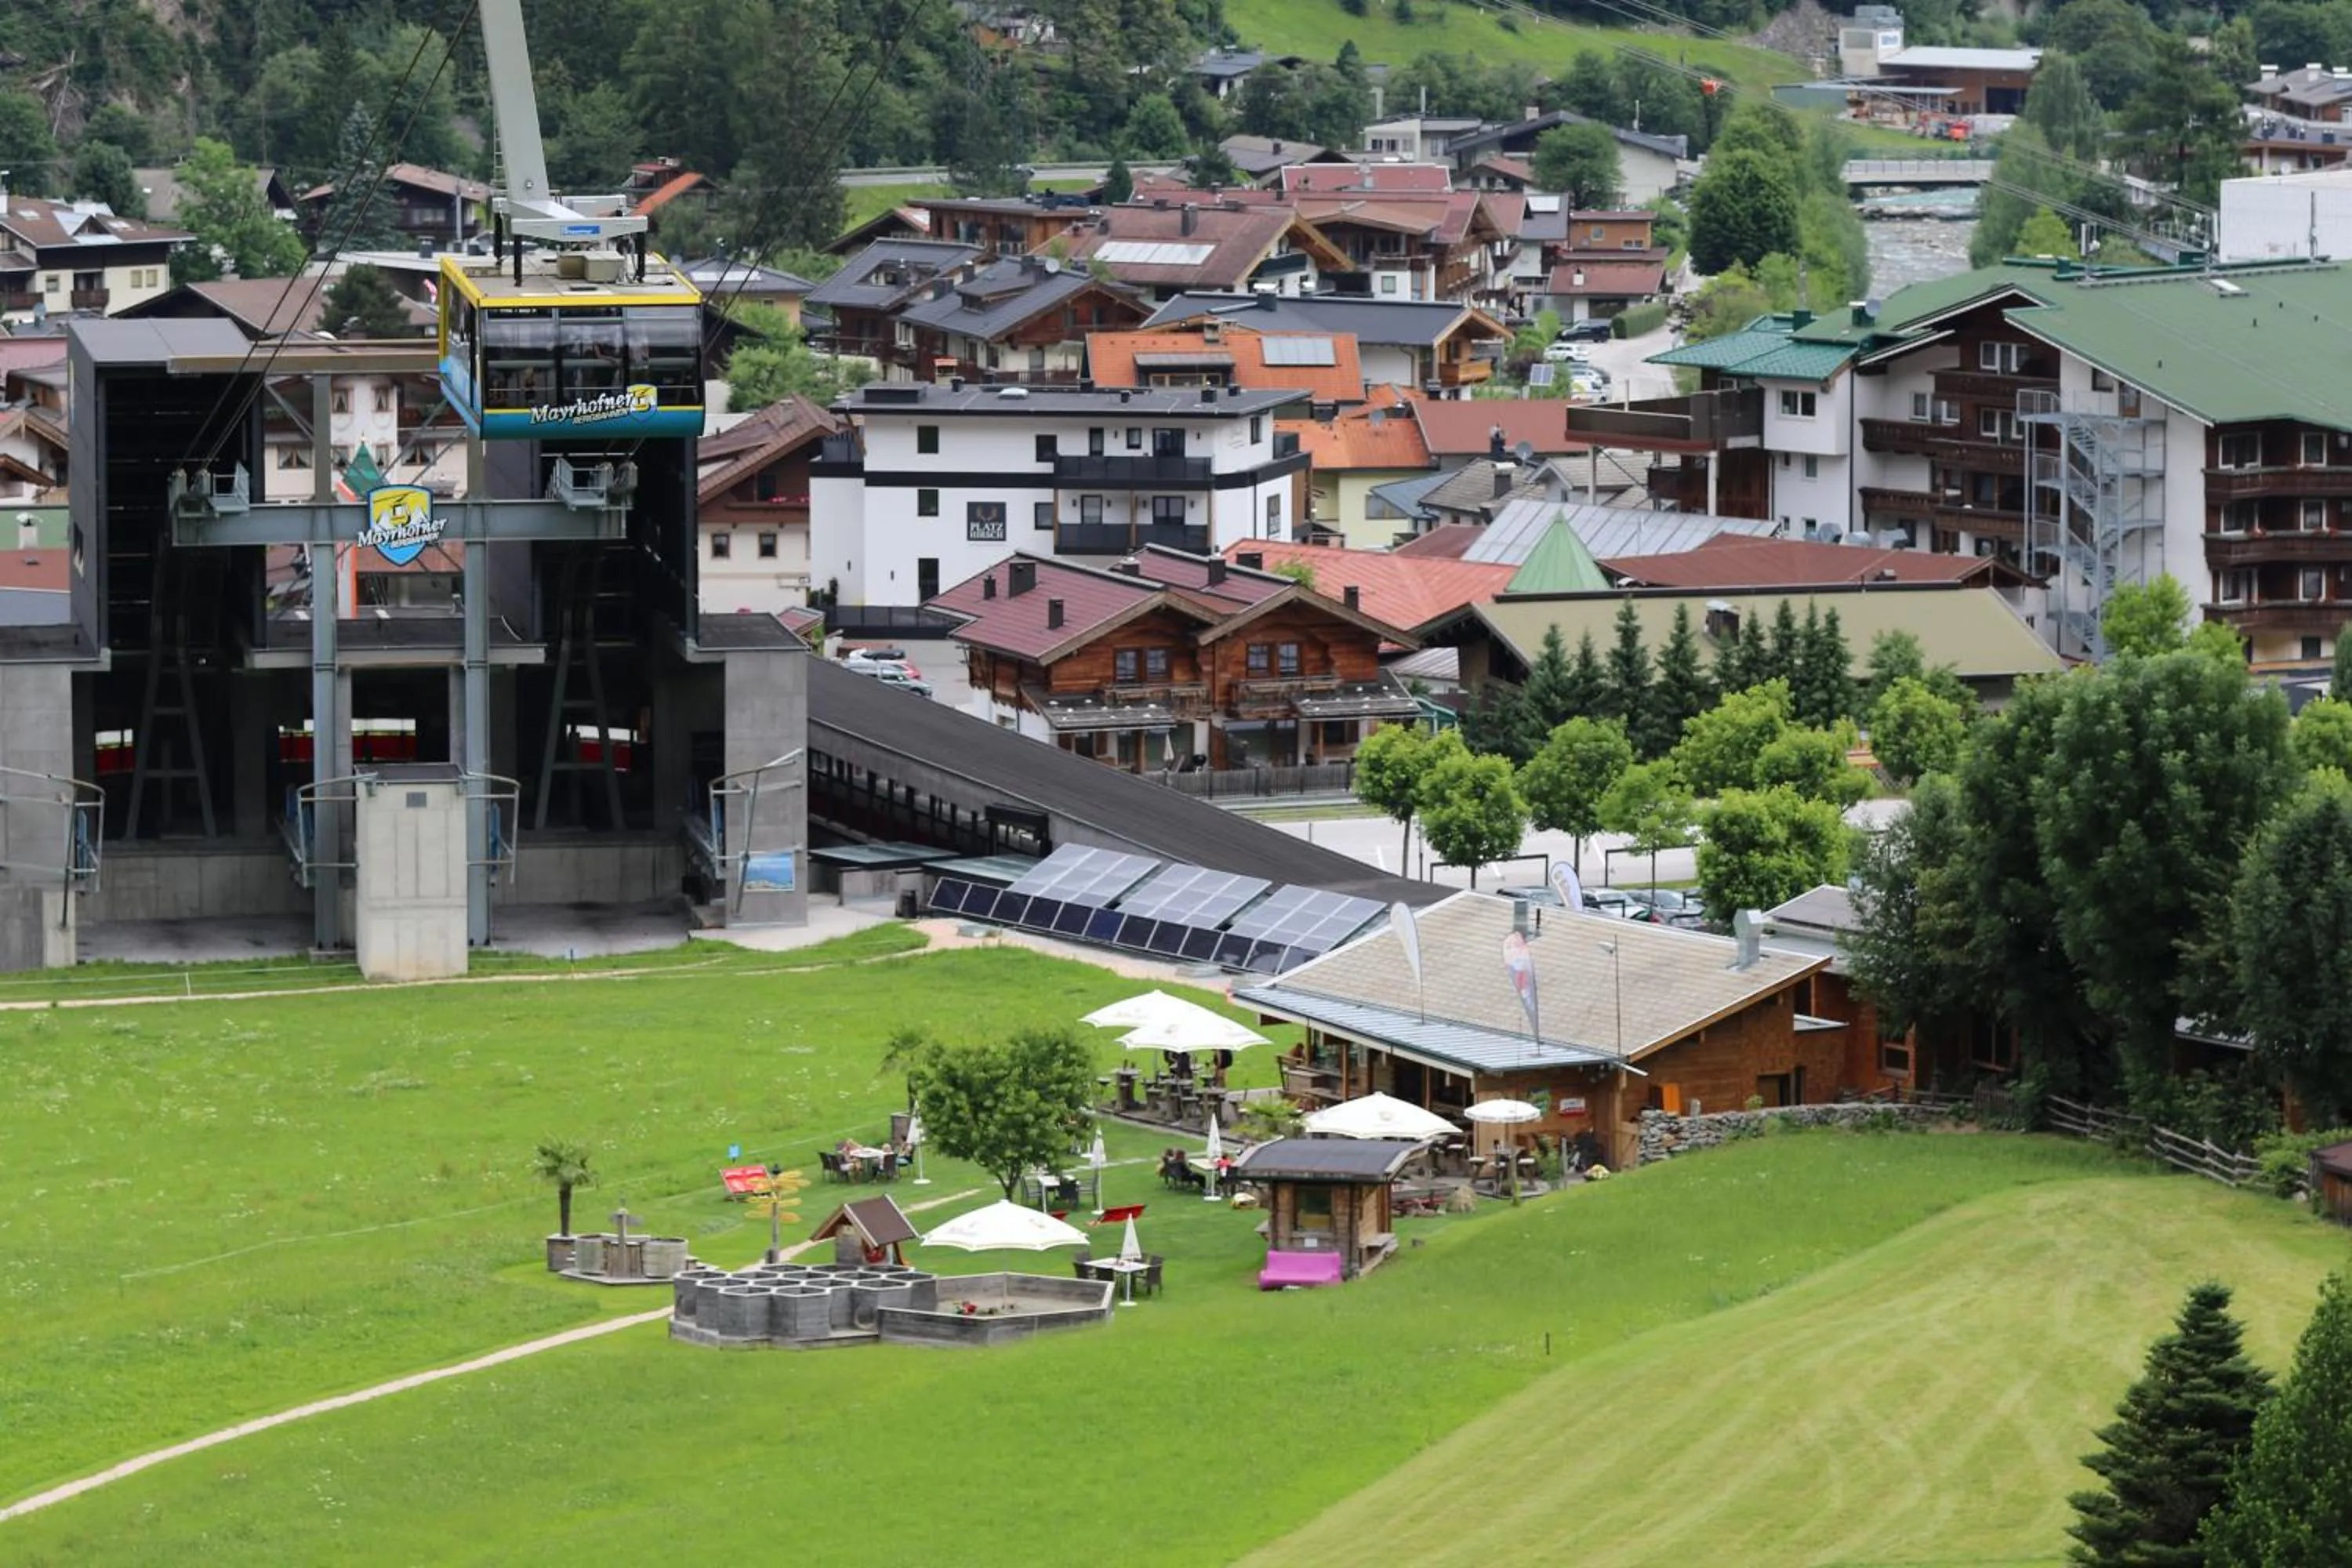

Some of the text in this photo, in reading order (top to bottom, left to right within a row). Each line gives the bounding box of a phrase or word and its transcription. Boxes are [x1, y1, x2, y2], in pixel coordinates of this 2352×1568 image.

[531, 393, 633, 423] Mayrhofner
[358, 518, 448, 547] Mayrhofner
[971, 521, 1004, 530] PLATZ
